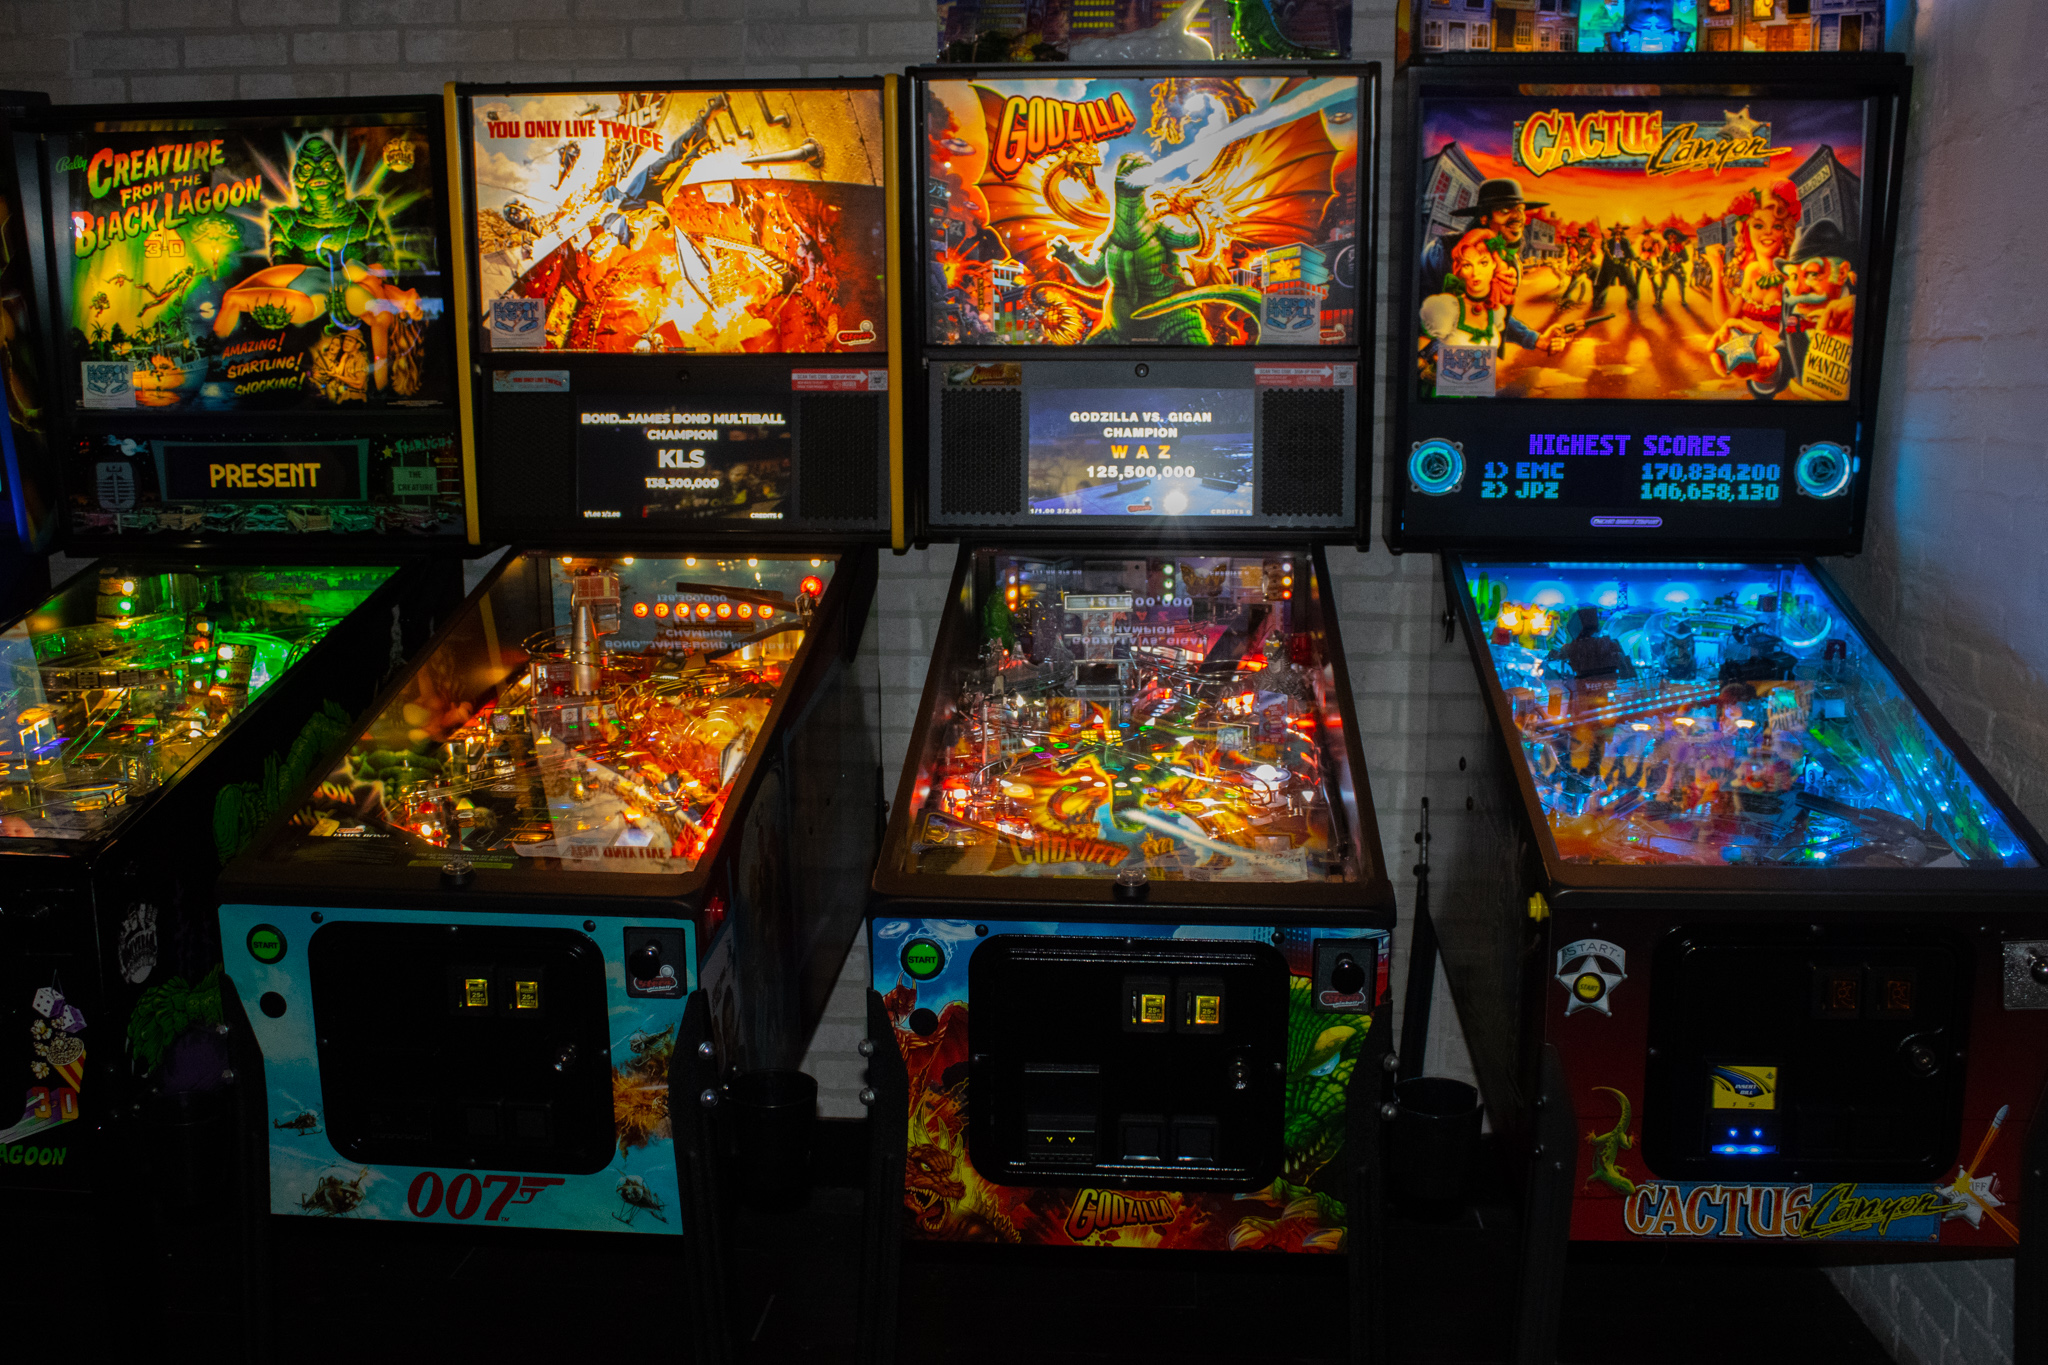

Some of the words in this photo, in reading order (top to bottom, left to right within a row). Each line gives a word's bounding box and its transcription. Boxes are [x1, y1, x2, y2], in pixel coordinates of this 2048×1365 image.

[487, 121, 520, 139] YOU
[524, 120, 562, 139] ONLY
[565, 120, 596, 138] LIVE
[598, 120, 664, 153] TWICE
[991, 92, 1136, 179] GODZILLA
[1520, 109, 1662, 177] CACTUS
[1646, 122, 1792, 176] Canyon
[56, 155, 88, 173] Bally
[87, 139, 225, 198] CREATURE
[120, 181, 164, 208] FROM
[169, 174, 202, 191] THE
[71, 199, 160, 259] BLACK
[164, 175, 262, 229] LAGOON
[222, 332, 285, 359] AMAZING!
[227, 352, 303, 379] STARTLING!
[1808, 353, 1850, 384] WANTED
[234, 372, 306, 397] SHOCKING!
[672, 413, 711, 425] BOND
[713, 413, 786, 425] MULTIBALL
[1069, 412, 1139, 423] GODZILLA
[1142, 412, 1164, 423] VS.
[1167, 412, 1212, 423] GIGAN
[647, 429, 718, 441] CHAMPION
[1103, 427, 1178, 438] CHAMPION
[1529, 434, 1631, 456] HIGHEST
[1643, 435, 1731, 456] SCORES
[658, 449, 706, 469] KLS
[209, 463, 321, 488] PRESENT
[644, 477, 720, 490] 138,300,000
[1087, 466, 1195, 480] 125,500,000
[1485, 462, 1509, 479] 1)
[1515, 462, 1565, 479] EMC
[1641, 463, 1781, 483] 170,834,200
[1481, 481, 1509, 499] 2)
[1640, 482, 1780, 502] 146,658,130
[908, 956, 936, 964] START
[1566, 943, 1618, 956] START
[0, 1143, 67, 1166] AGOON
[407, 1171, 526, 1221] 007
[1064, 1188, 1176, 1241] GODZILLA
[1625, 1184, 1813, 1237] CACTUS
[1800, 1183, 1967, 1238] Canyon
